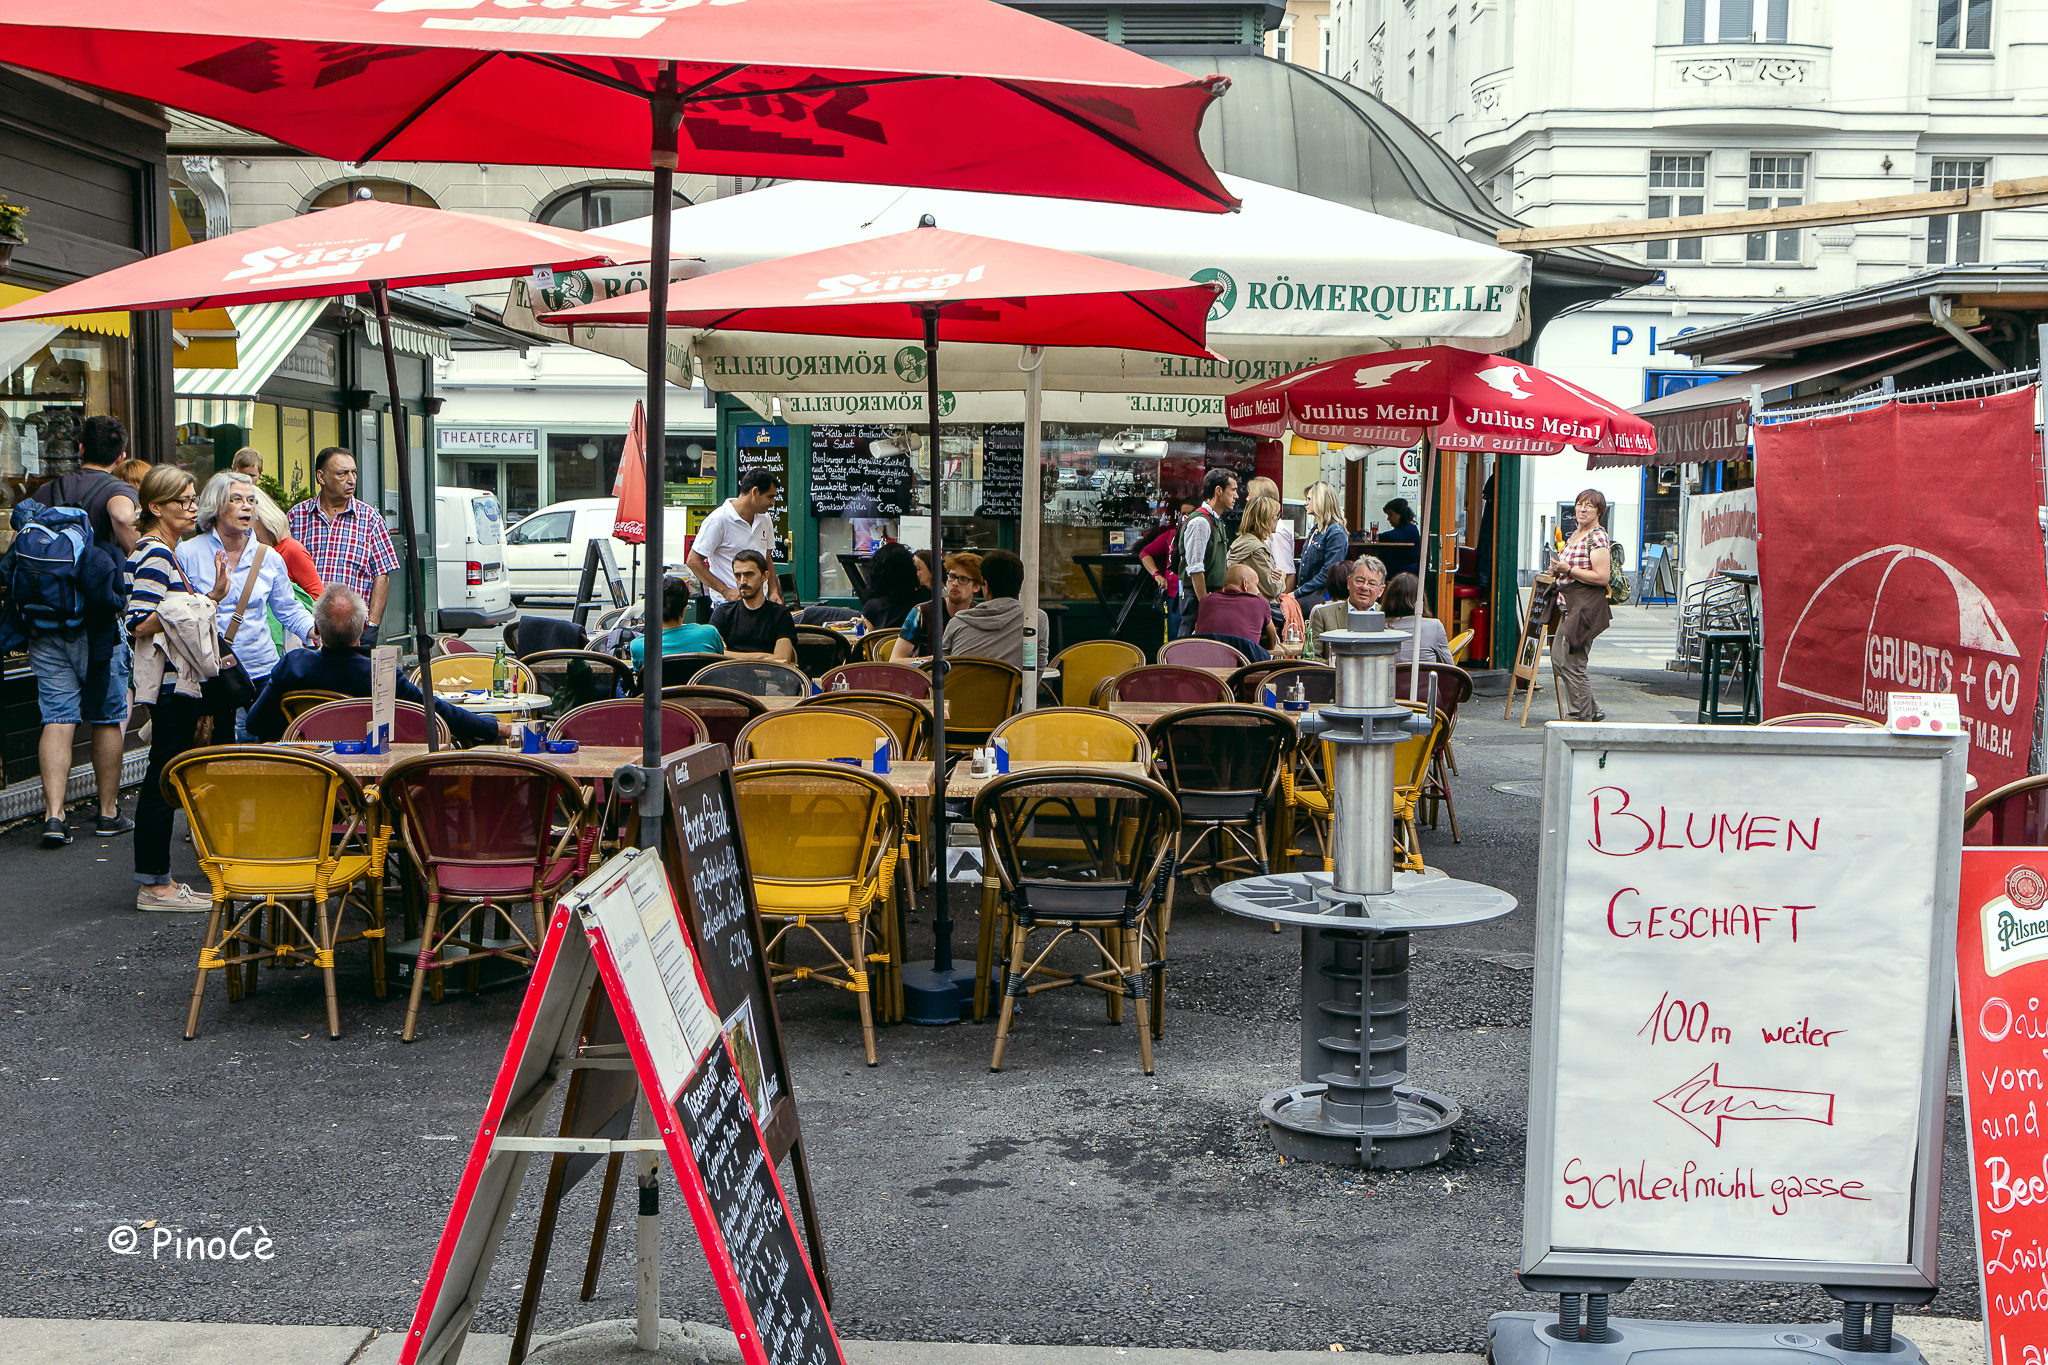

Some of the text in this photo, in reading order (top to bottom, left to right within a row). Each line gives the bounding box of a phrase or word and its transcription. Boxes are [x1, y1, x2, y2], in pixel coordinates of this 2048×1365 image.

[221, 231, 407, 282] Stiegl
[802, 264, 986, 300] Stiegl
[1230, 398, 1280, 420] Julius Meinl
[1301, 403, 1439, 421] Julius Meinl
[1466, 407, 1600, 440] Julius Meinl
[442, 429, 533, 444] THEATERCAFÉ
[833, 439, 855, 449] Salat
[1402, 476, 1419, 487] Zon
[1869, 634, 1953, 694] GRUBITS
[1985, 660, 2020, 715] CO
[1976, 720, 2013, 758] M.B.H.
[1588, 786, 1820, 856] BLUMEN
[1607, 887, 1817, 943] GESCHAFT
[1762, 1017, 1848, 1047] weiter
[1981, 1065, 2044, 1095] vom
[1981, 1100, 2040, 1140] und
[1996, 1271, 2048, 1316] und
